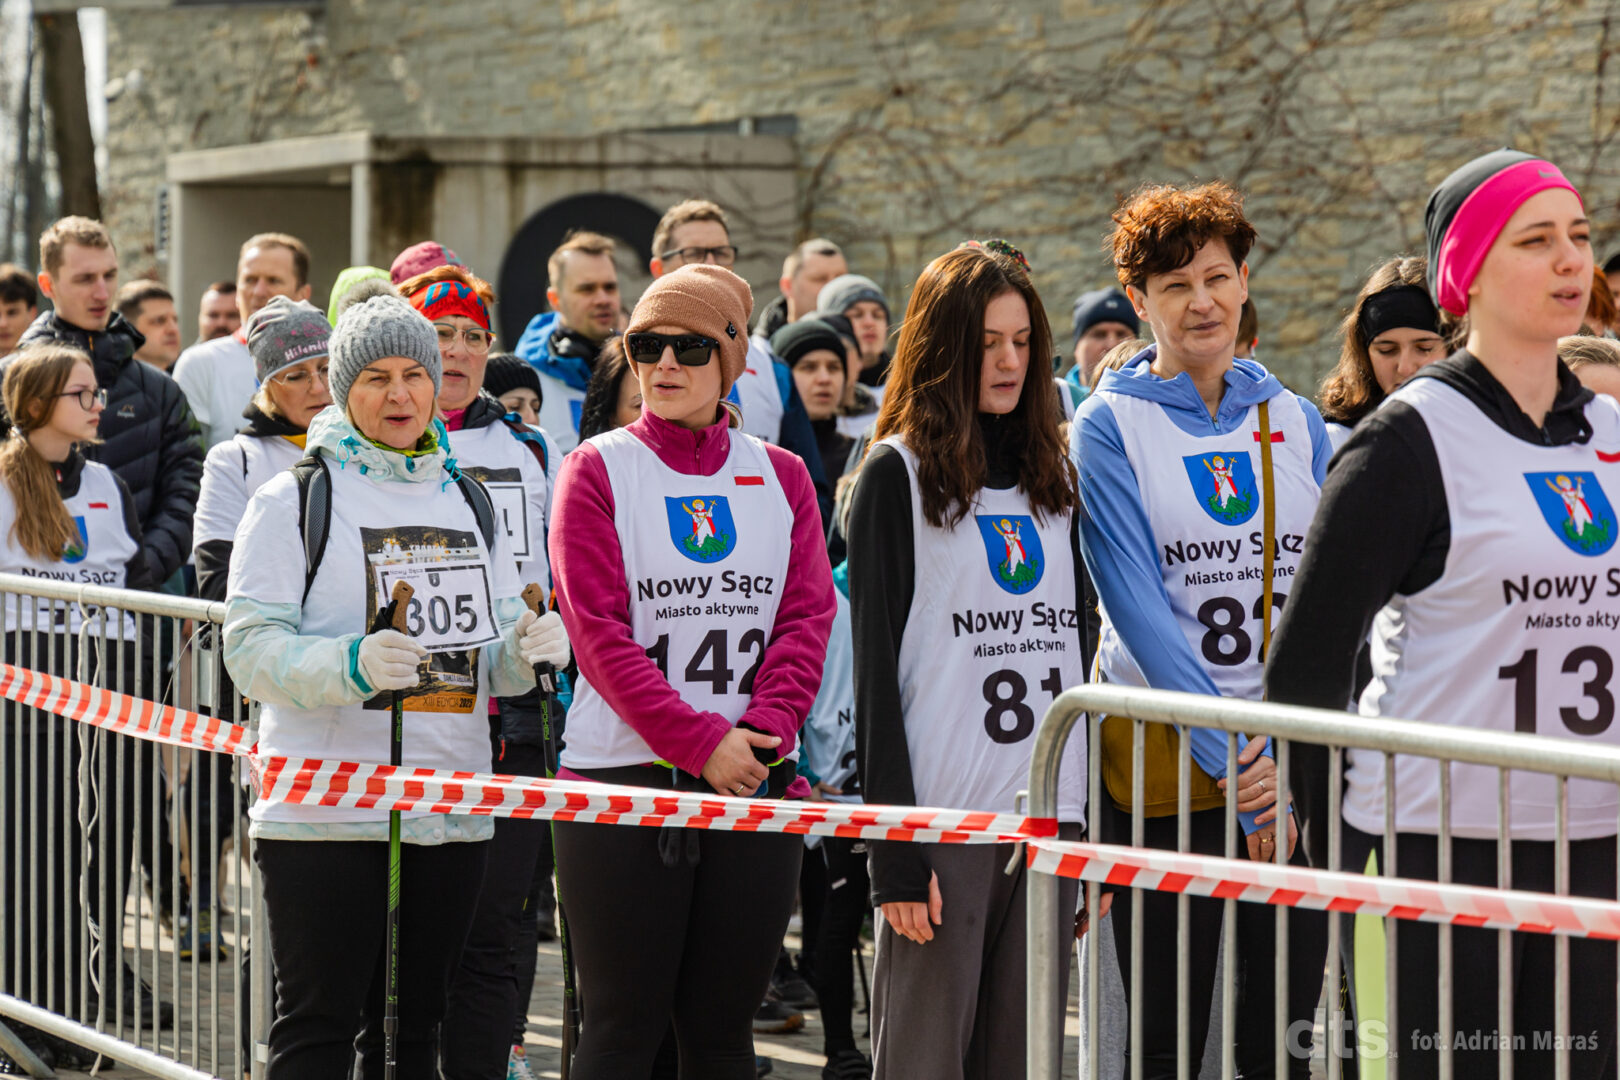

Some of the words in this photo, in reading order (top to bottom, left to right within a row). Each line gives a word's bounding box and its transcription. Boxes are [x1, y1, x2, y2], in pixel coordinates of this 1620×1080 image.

[1164, 539, 1242, 566] Nowy
[637, 576, 713, 602] Nowy
[721, 570, 774, 599] Sącz
[1185, 570, 1234, 587] Miasto
[1502, 575, 1597, 606] Nowy
[406, 594, 478, 638] 305
[656, 604, 702, 621] Miasto
[705, 602, 759, 617] aktywne
[952, 609, 1024, 638] Nowy
[1031, 602, 1077, 634] Sącz
[1525, 612, 1582, 630] Miasto
[646, 627, 765, 695] 142
[974, 641, 1017, 658] Miasto
[1498, 645, 1616, 737] 13
